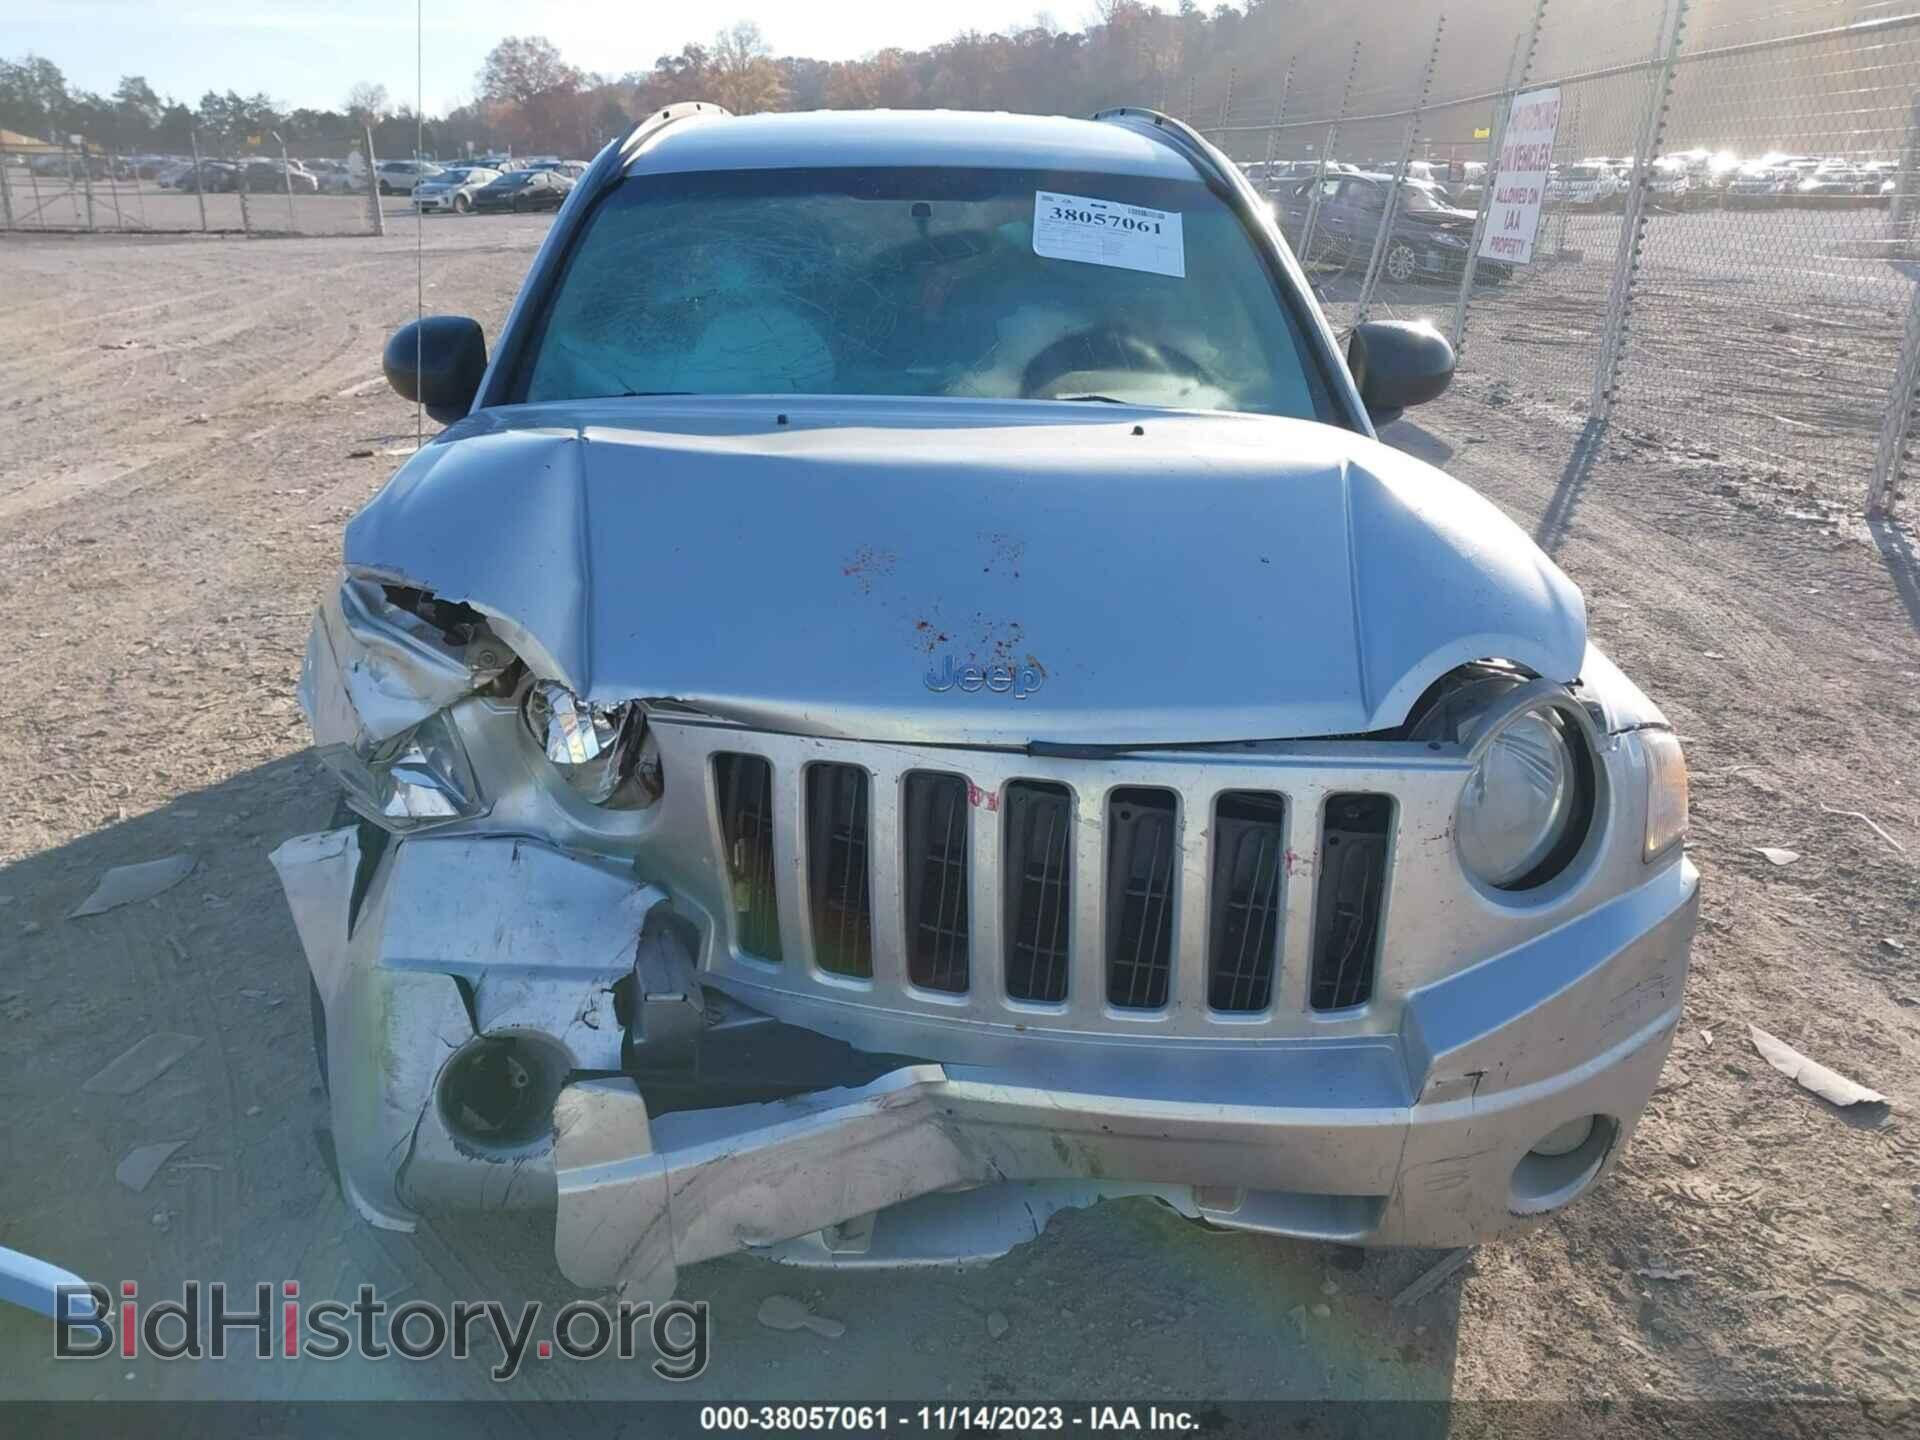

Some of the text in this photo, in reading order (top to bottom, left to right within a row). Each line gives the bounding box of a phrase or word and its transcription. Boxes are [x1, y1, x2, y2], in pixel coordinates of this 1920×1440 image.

[1496, 187, 1538, 204] ALLOWED ON
[1050, 207, 1161, 235] 38057061
[1504, 209, 1521, 231] IAA
[1490, 236, 1525, 254] PROPERTY
[923, 655, 1043, 699] Jeep
